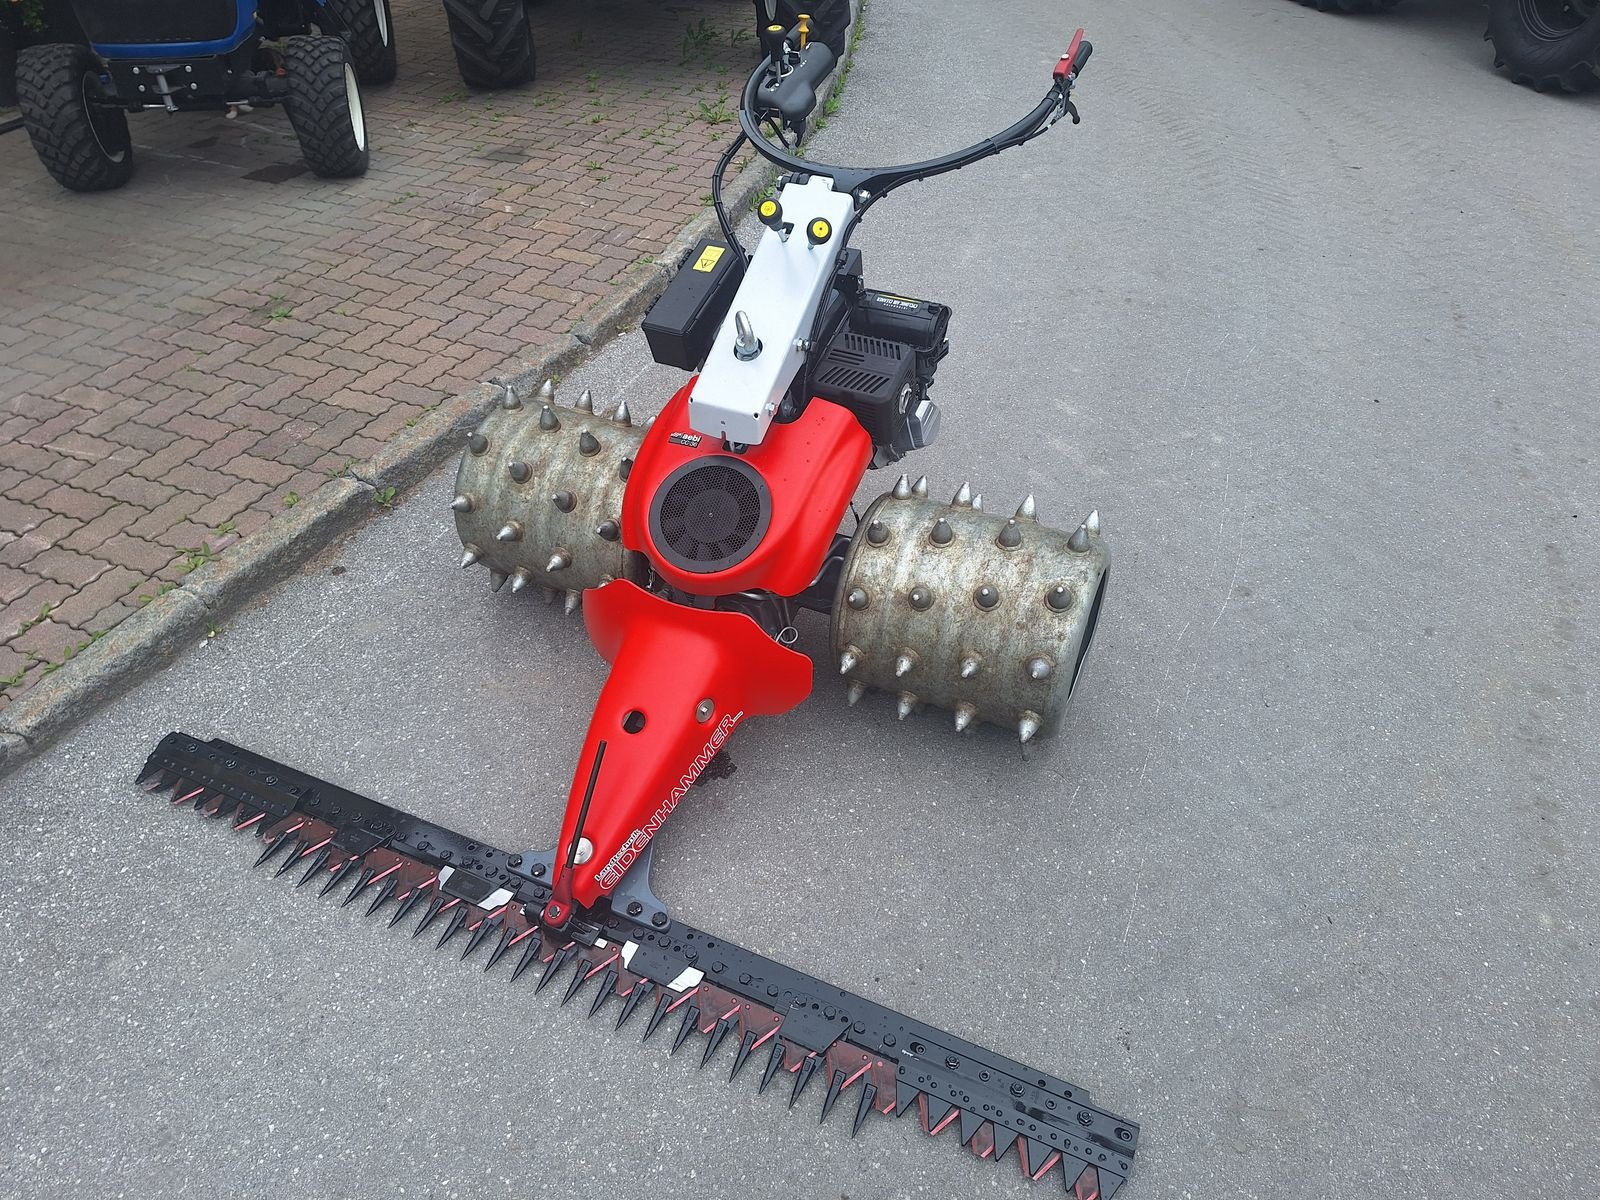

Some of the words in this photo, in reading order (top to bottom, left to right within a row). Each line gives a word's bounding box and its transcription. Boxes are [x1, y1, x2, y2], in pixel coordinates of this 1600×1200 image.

[682, 434, 702, 442] aebi
[600, 711, 743, 889] EIDENHAMMER
[594, 828, 642, 882] Landtechnik
